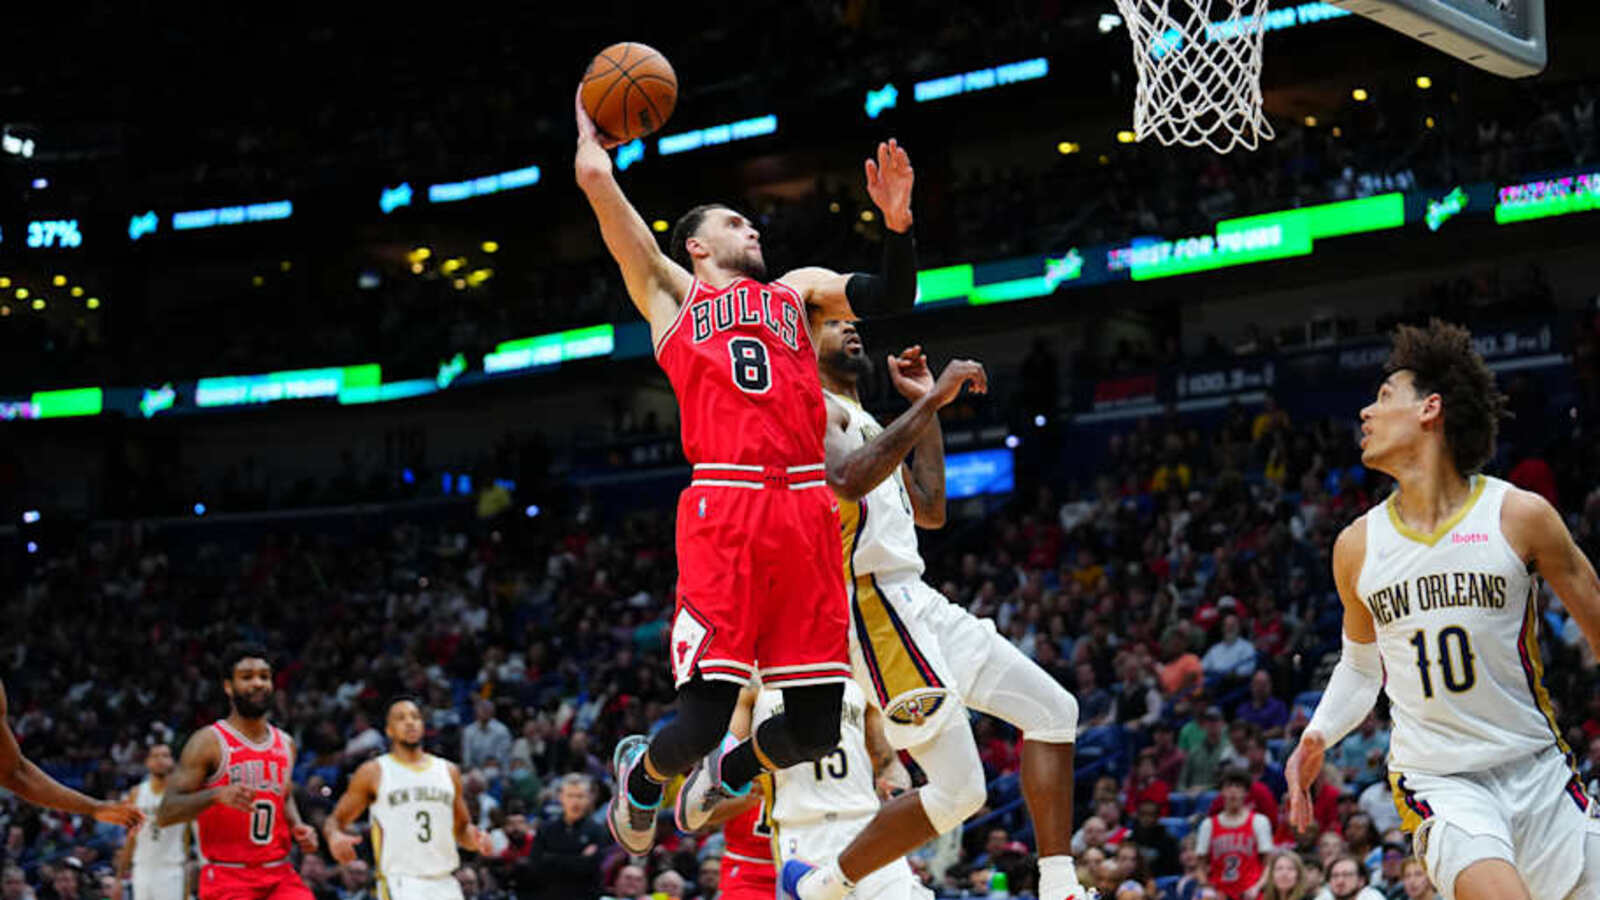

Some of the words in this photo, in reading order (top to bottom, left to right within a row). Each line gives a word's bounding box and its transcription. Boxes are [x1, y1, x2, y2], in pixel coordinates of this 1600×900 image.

[27, 218, 82, 248] 37%
[691, 286, 799, 351] BULLS
[728, 336, 772, 394] 8
[1367, 580, 1411, 627] NEW
[1416, 573, 1508, 612] ORLEANS
[1409, 625, 1477, 699] 10
[250, 800, 275, 844] 0
[415, 810, 432, 843] 3
[1222, 855, 1241, 882] 2
